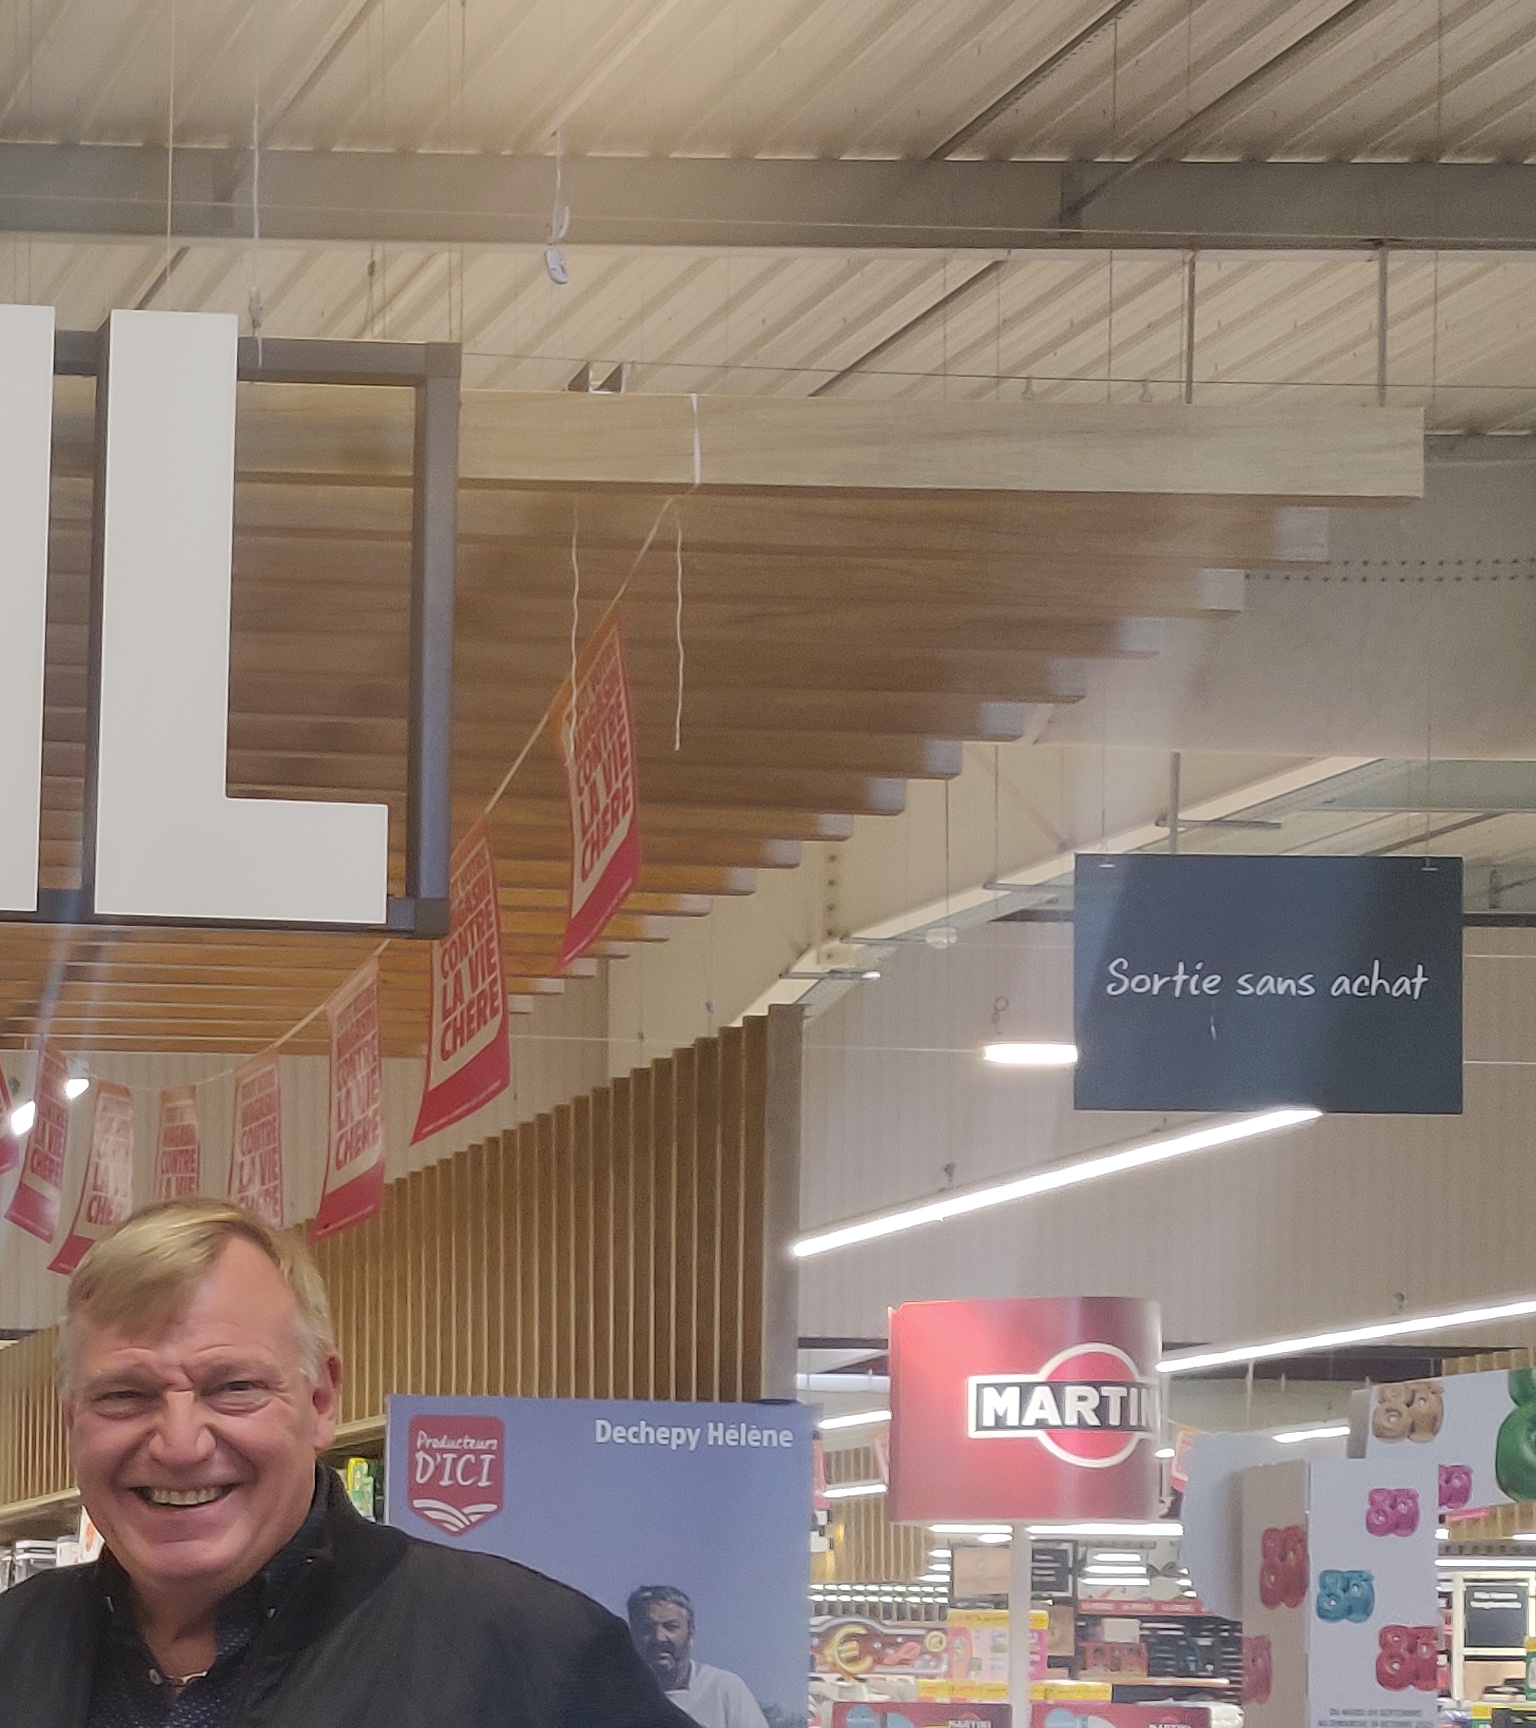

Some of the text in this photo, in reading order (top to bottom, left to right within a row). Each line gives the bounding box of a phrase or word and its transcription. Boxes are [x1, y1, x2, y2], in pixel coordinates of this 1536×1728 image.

[1105, 958, 1429, 999] Sortie sans achat
[417, 1430, 498, 1450] Producteurs
[596, 1420, 794, 1450] Dechepy Hélène
[415, 1452, 495, 1486] D'ICI
